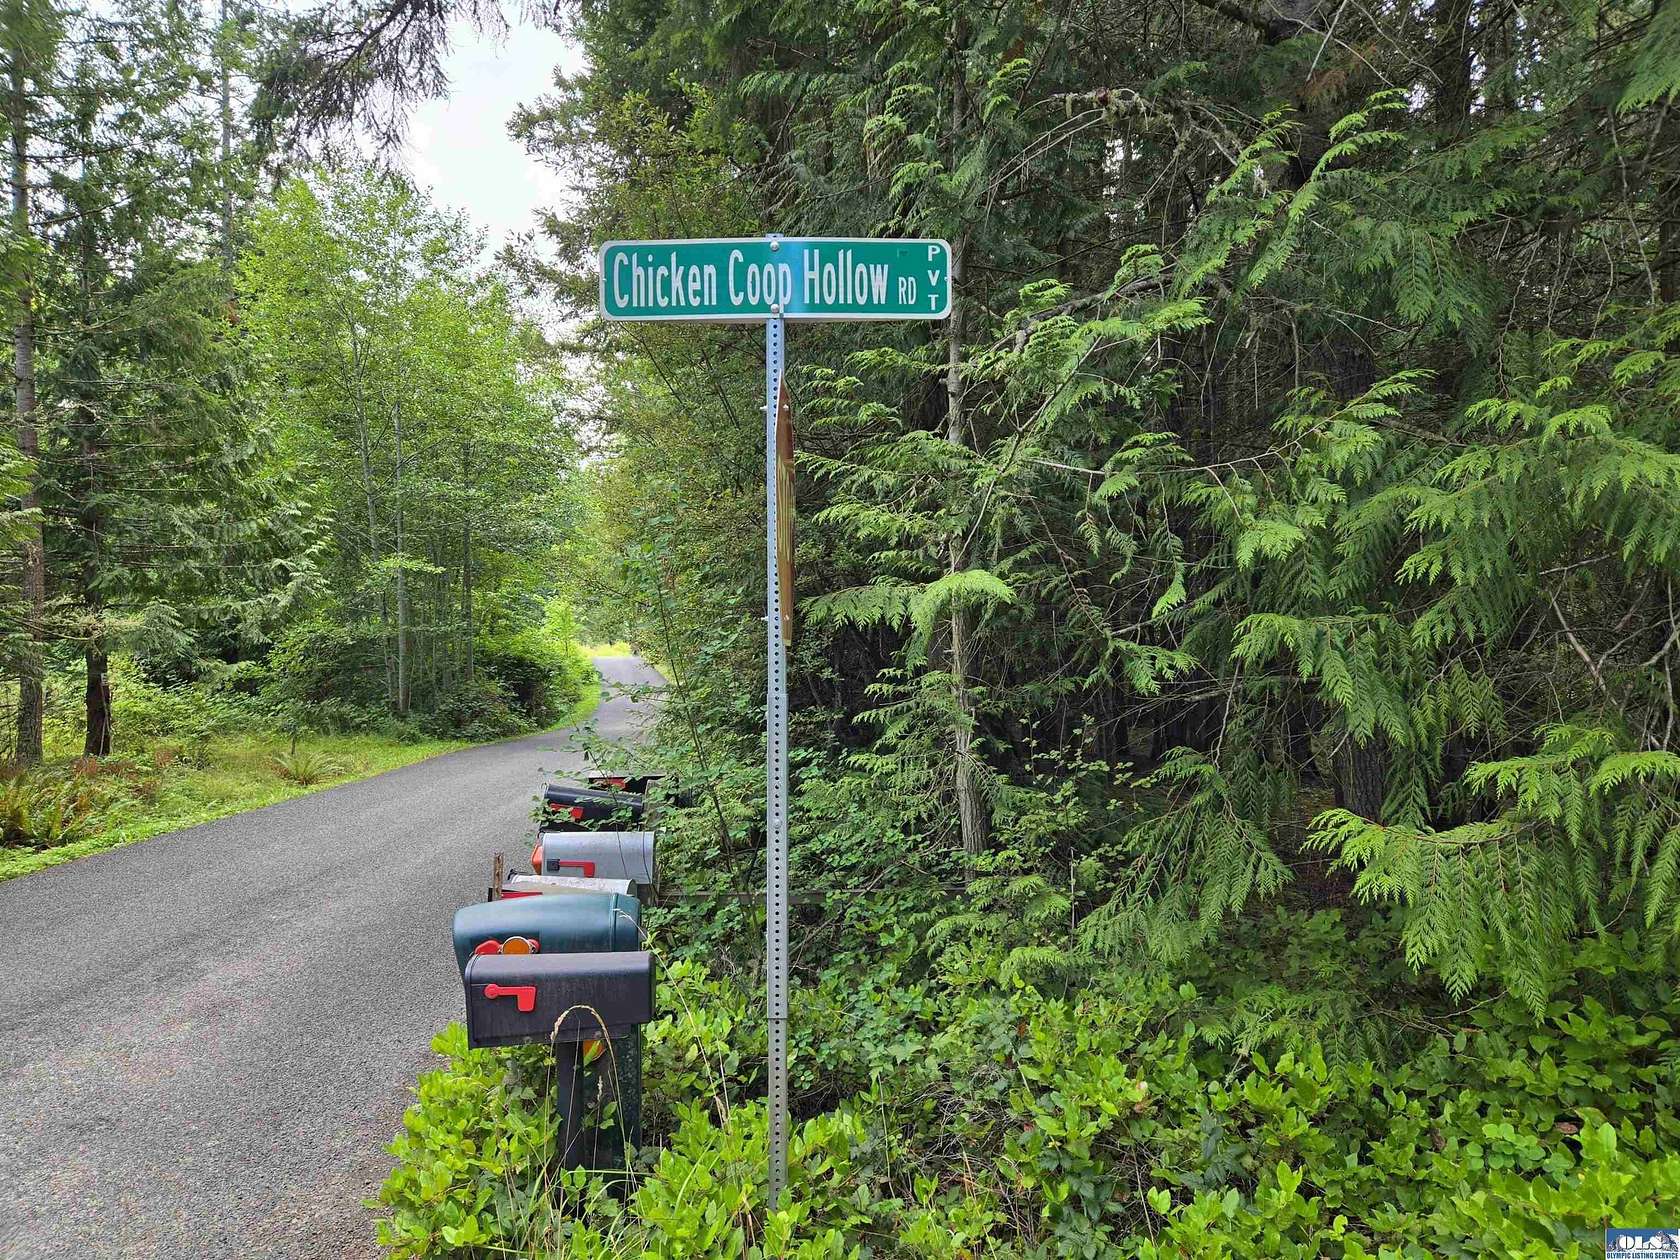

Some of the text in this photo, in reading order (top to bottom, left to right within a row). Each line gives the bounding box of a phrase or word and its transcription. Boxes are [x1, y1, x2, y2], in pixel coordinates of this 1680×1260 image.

[613, 249, 917, 314] Chicken Coop Hollow RD
